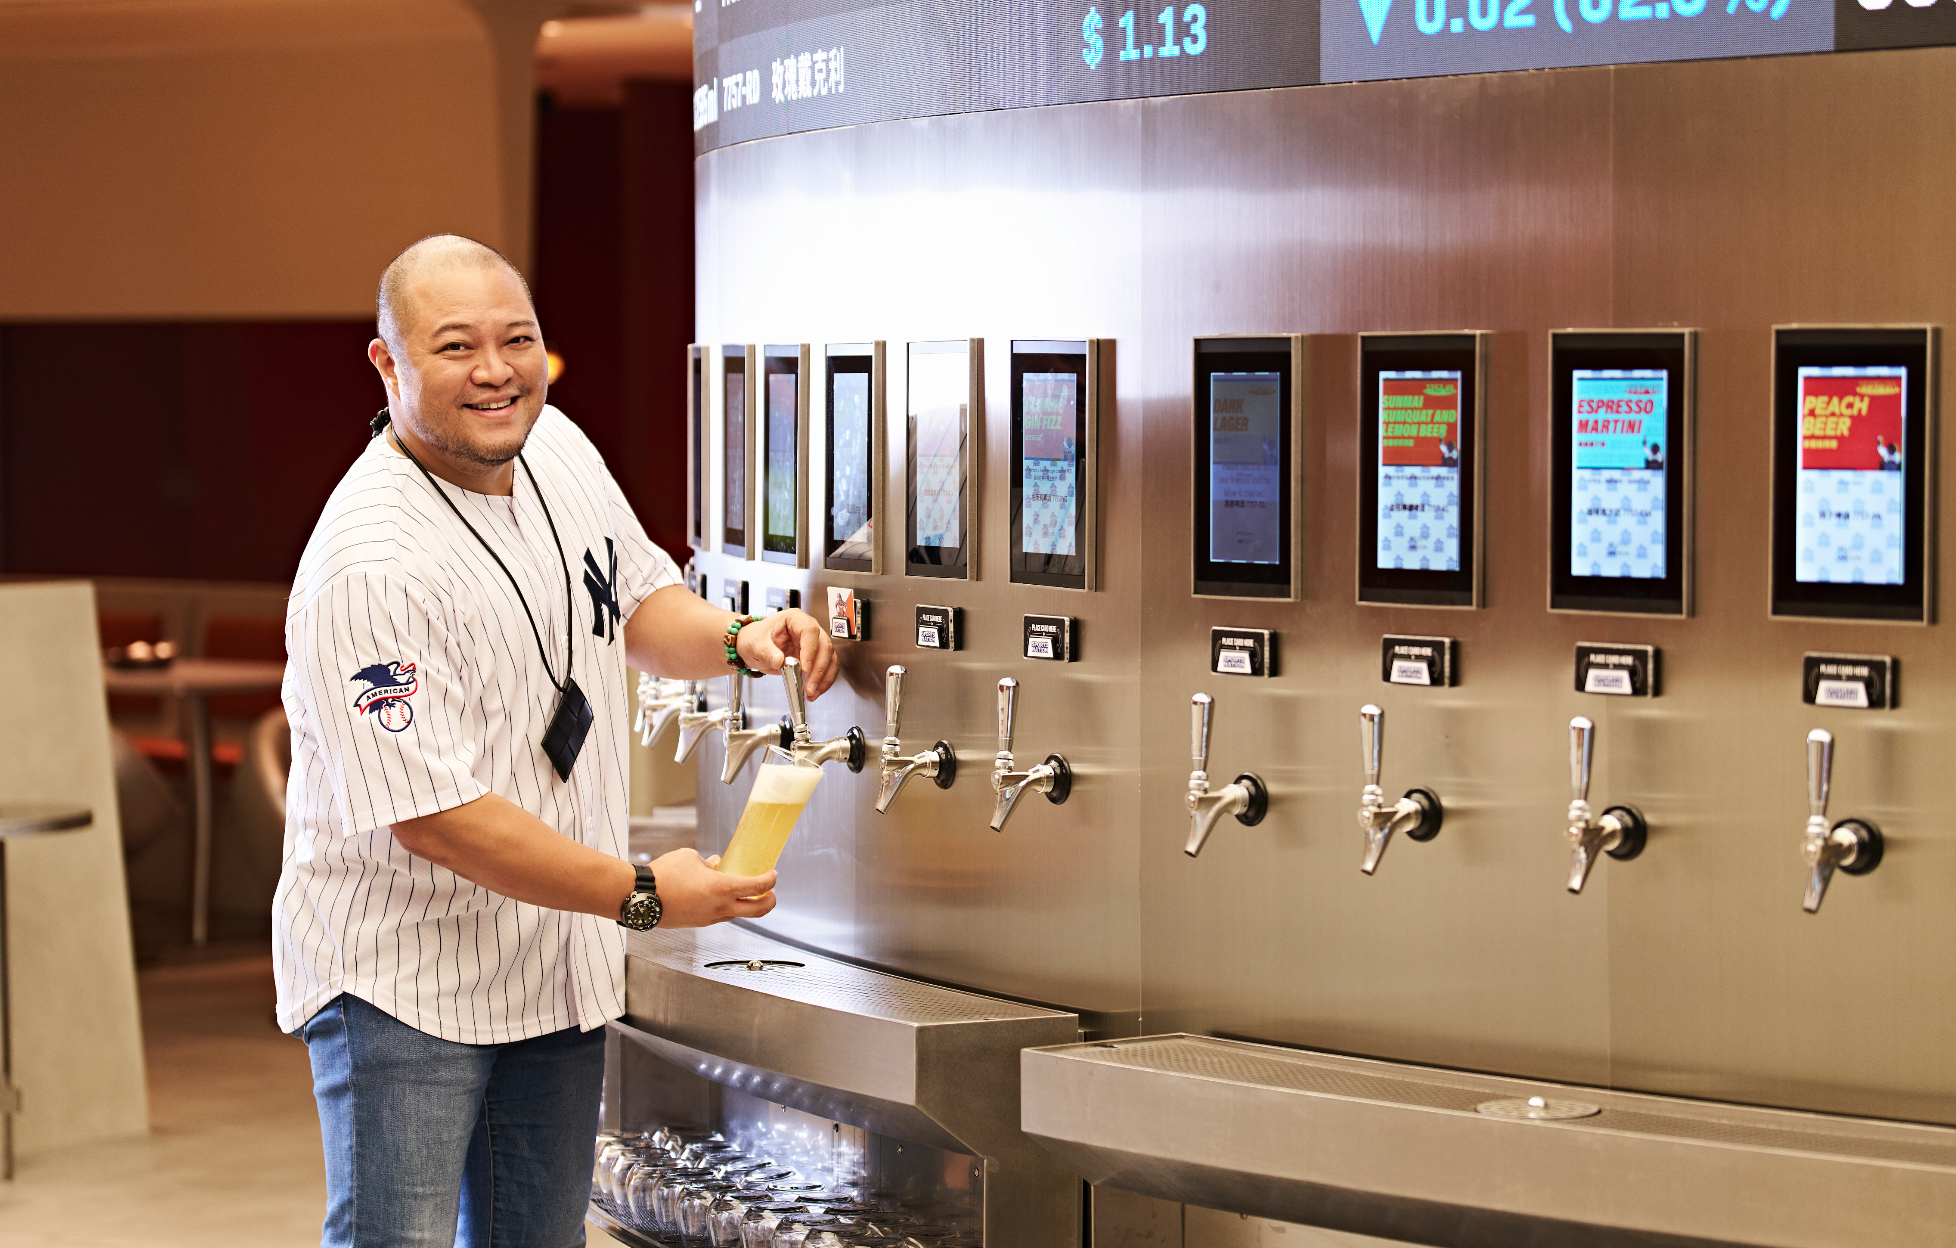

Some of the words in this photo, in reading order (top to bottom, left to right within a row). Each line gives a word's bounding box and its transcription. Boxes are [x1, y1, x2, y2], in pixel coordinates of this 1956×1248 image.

[1082, 6, 1104, 70] $
[1118, 3, 1207, 61] 1.13
[722, 69, 760, 112] 7757-RD
[1213, 398, 1244, 414] DARK
[1382, 395, 1424, 408] SUNMAI
[1577, 399, 1654, 415] ESPRESSO
[1804, 395, 1870, 417] PEACH
[1025, 415, 1041, 430] GIN
[1042, 416, 1062, 430] FIZZ
[1213, 416, 1249, 432] LAGER
[1382, 409, 1433, 423] KUMQUAT
[1434, 409, 1457, 423] AND
[1382, 423, 1419, 437] LEMON
[1419, 423, 1447, 437] BEER
[1577, 419, 1642, 434] MARTINI
[1803, 416, 1852, 437] BEER
[583, 535, 621, 646] NY
[366, 687, 410, 701] AMERICAN
